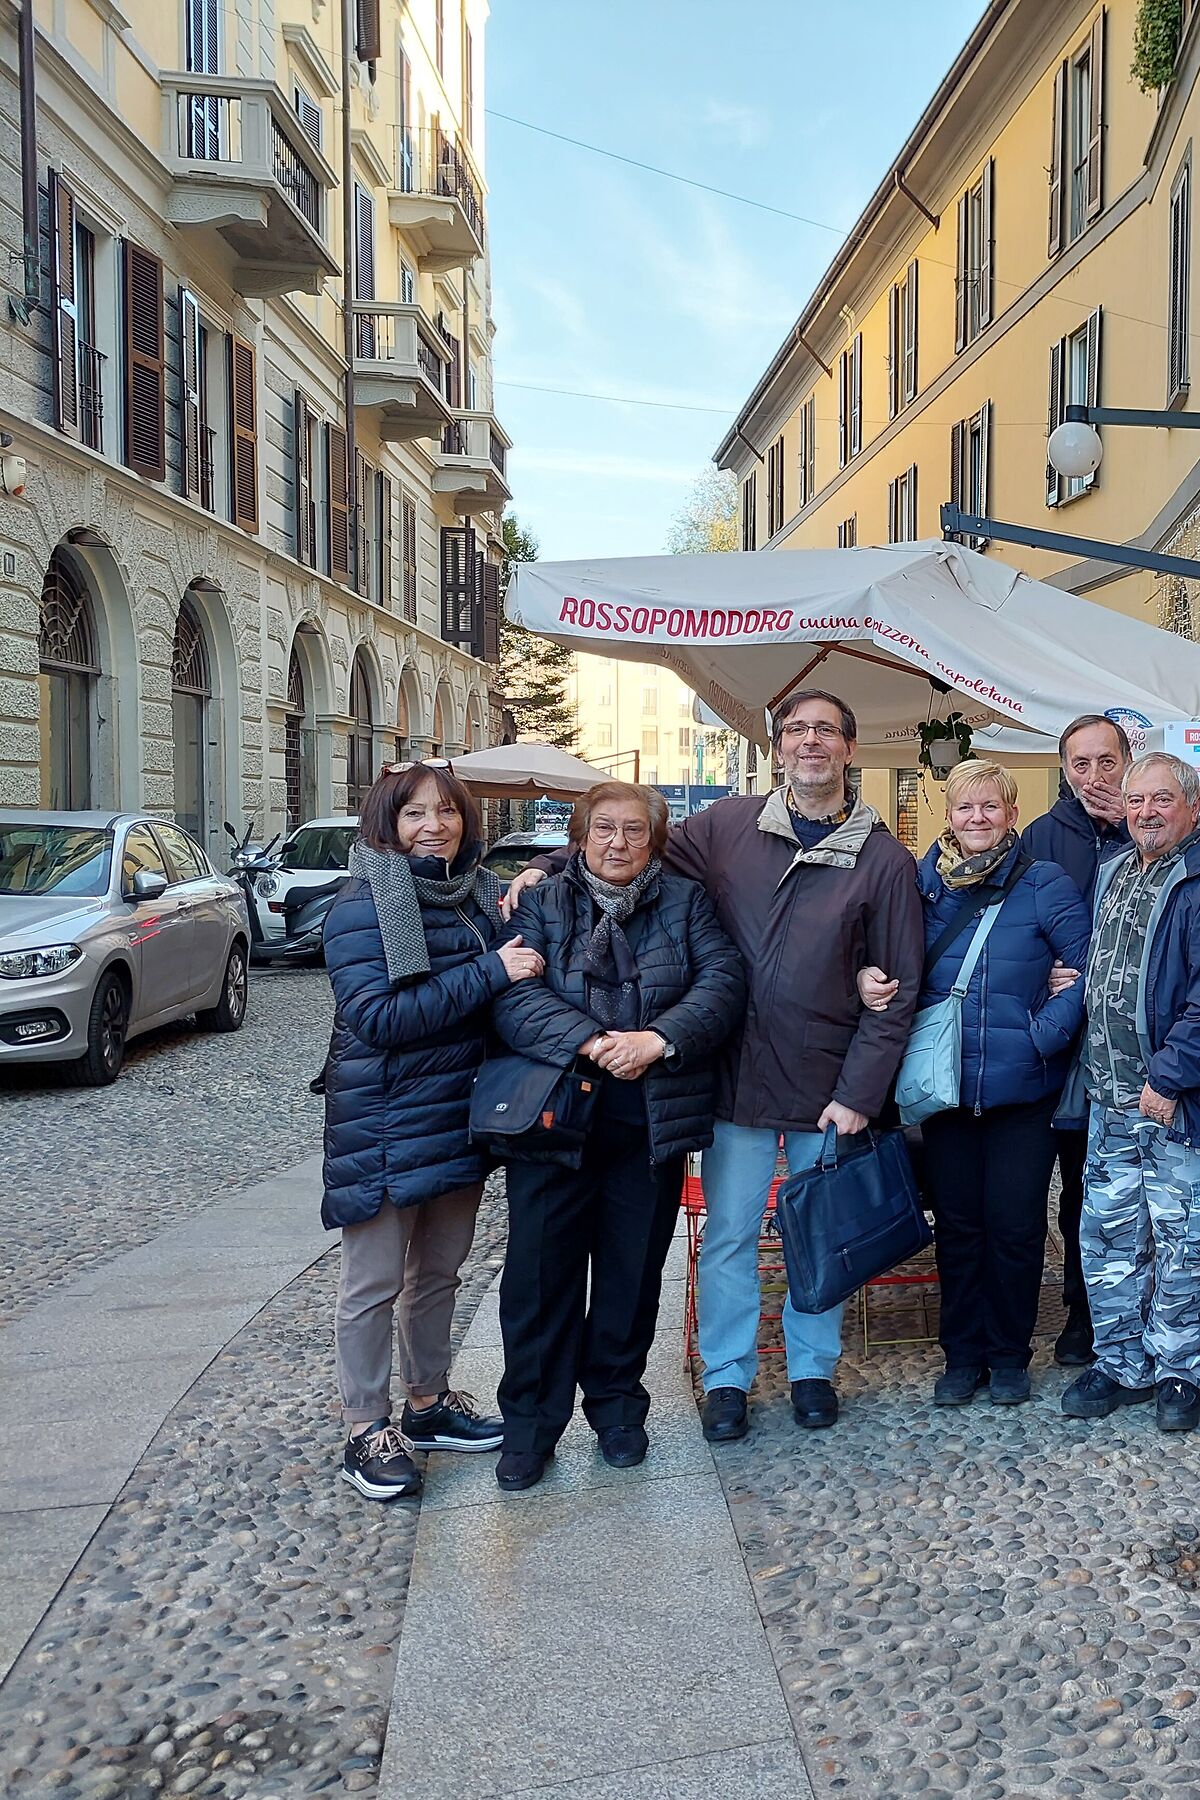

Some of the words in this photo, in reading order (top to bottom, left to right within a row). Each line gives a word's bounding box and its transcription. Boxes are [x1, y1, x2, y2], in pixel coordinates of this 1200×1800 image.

[558, 596, 794, 638] ROSSOPOMODORO
[799, 614, 860, 630] cucina
[936, 660, 1025, 714] napoletana
[1127, 729, 1146, 741] TRO
